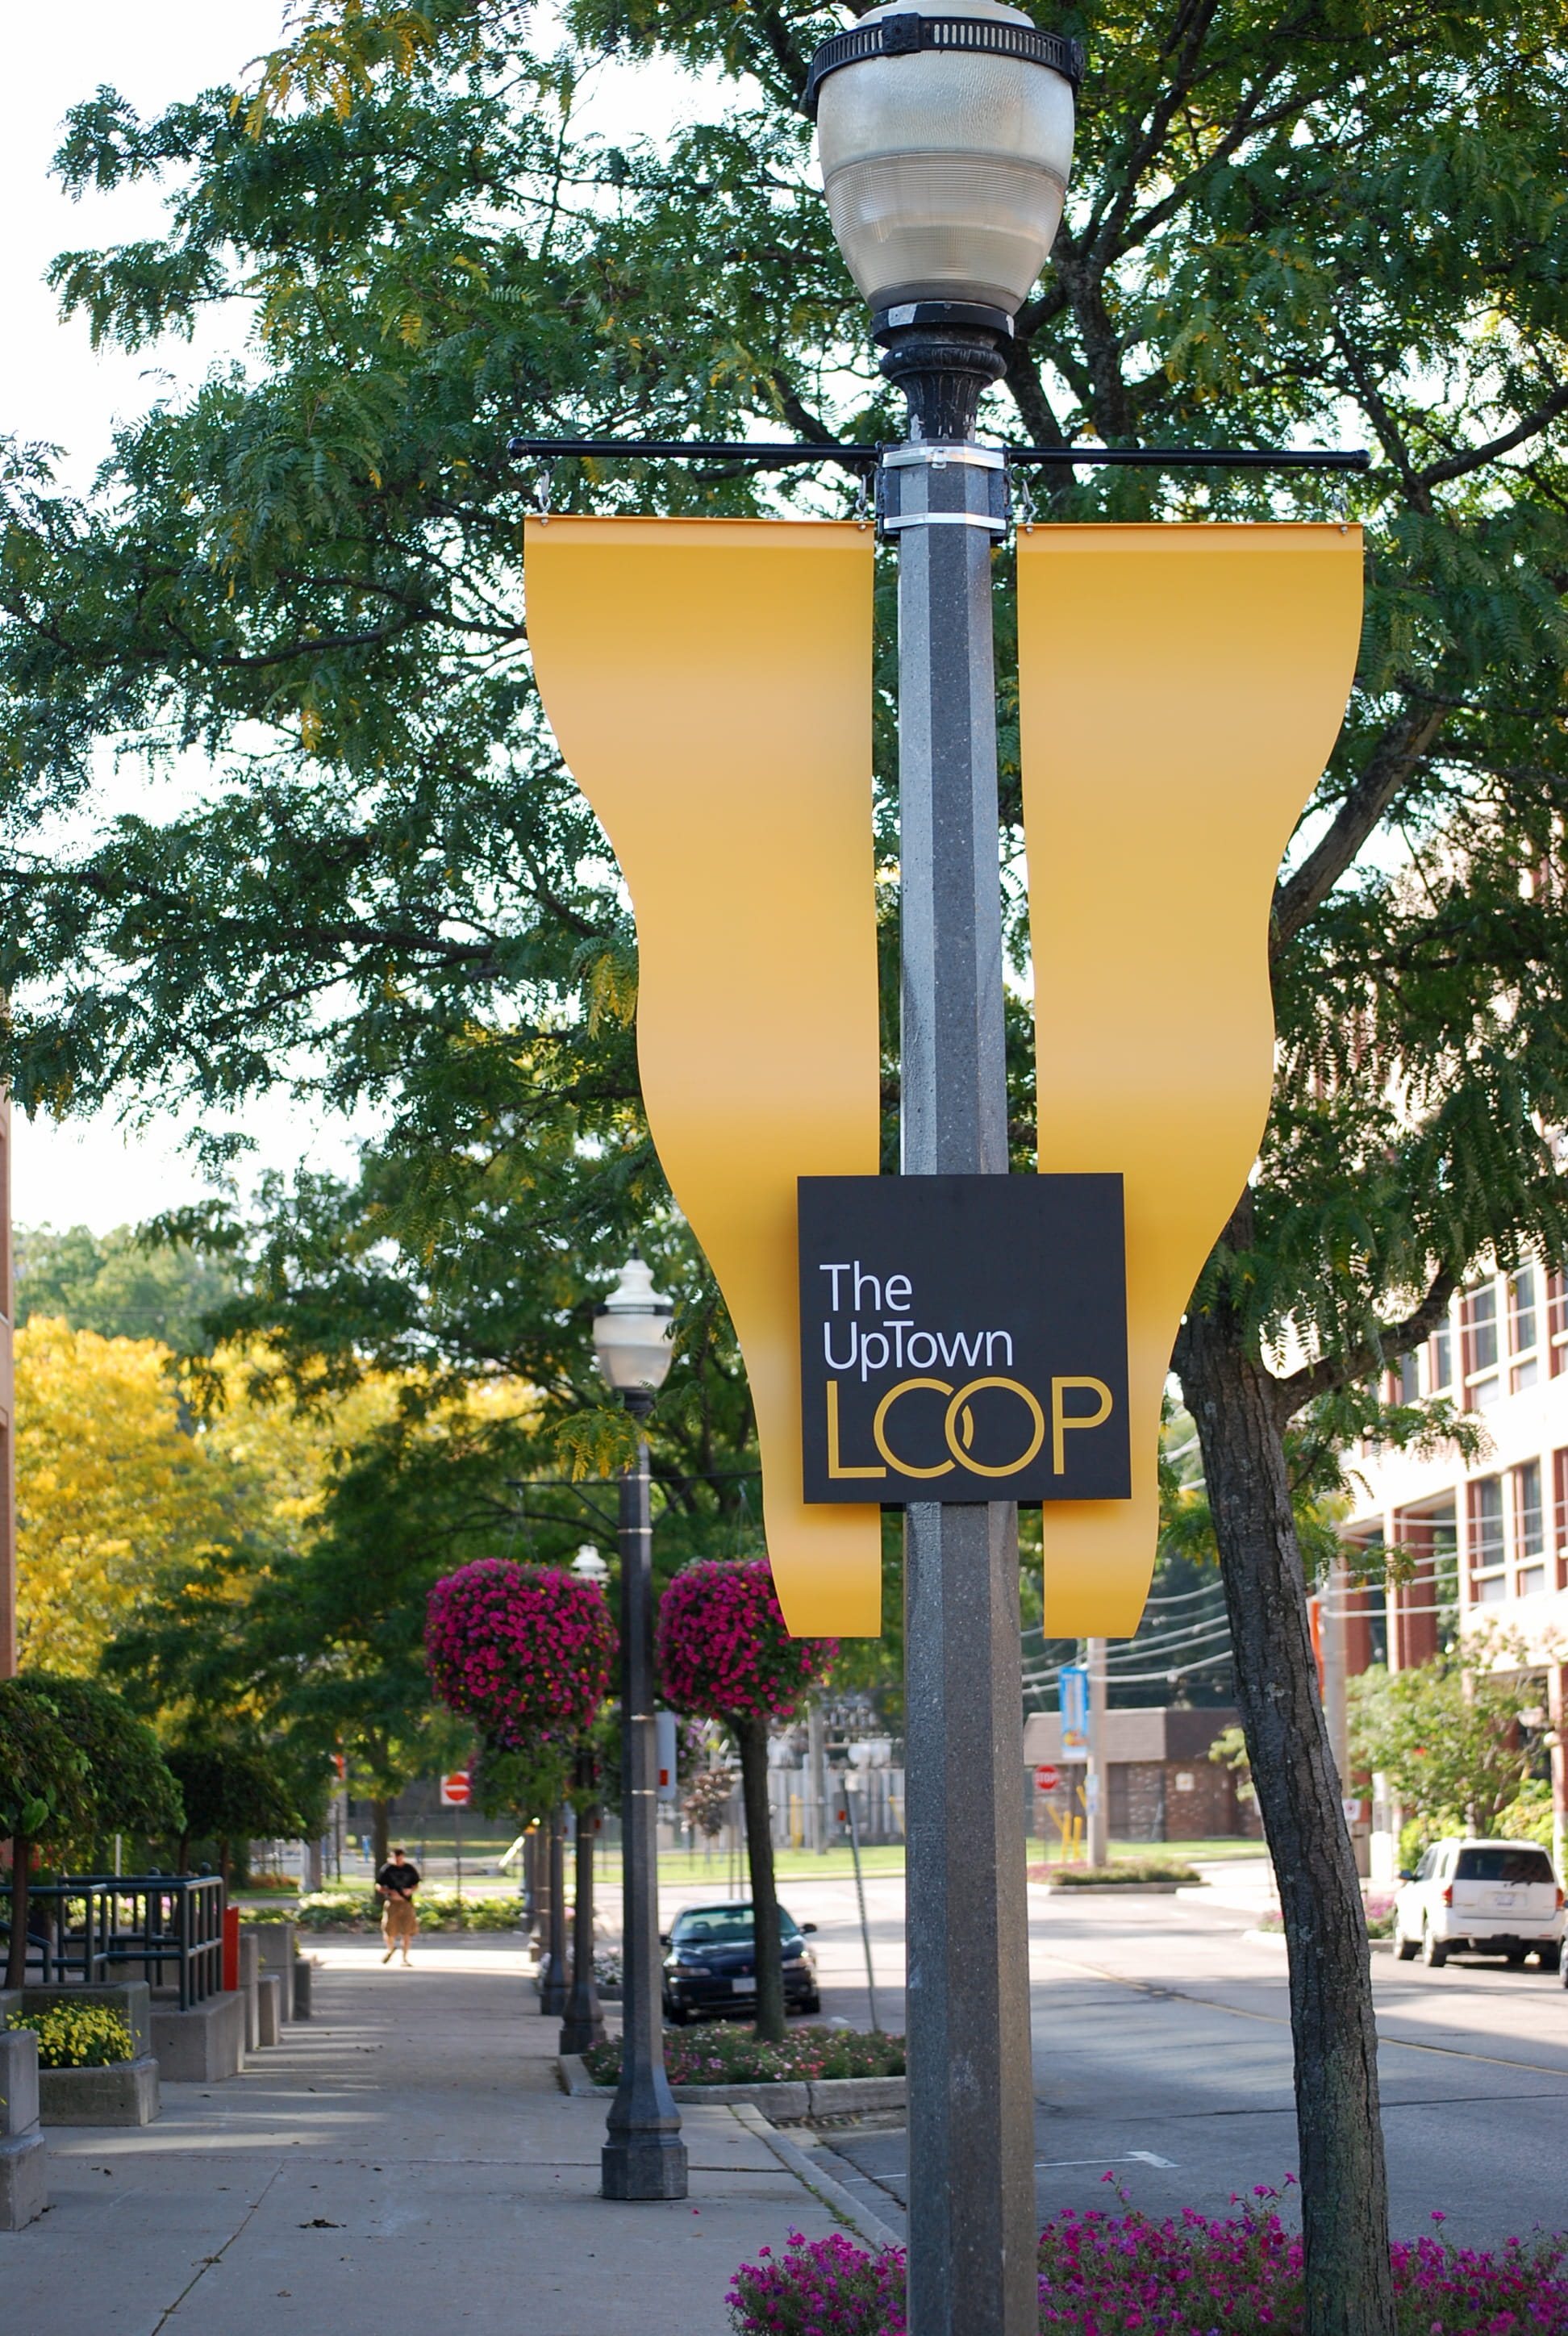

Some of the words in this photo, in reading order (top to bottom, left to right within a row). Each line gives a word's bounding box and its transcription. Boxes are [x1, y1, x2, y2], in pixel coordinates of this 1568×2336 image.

[819, 1261, 912, 1311] The
[824, 1320, 1013, 1382] UpTown
[826, 1376, 1113, 1479] LOOP
[1035, 1772, 1060, 1783] STOP
